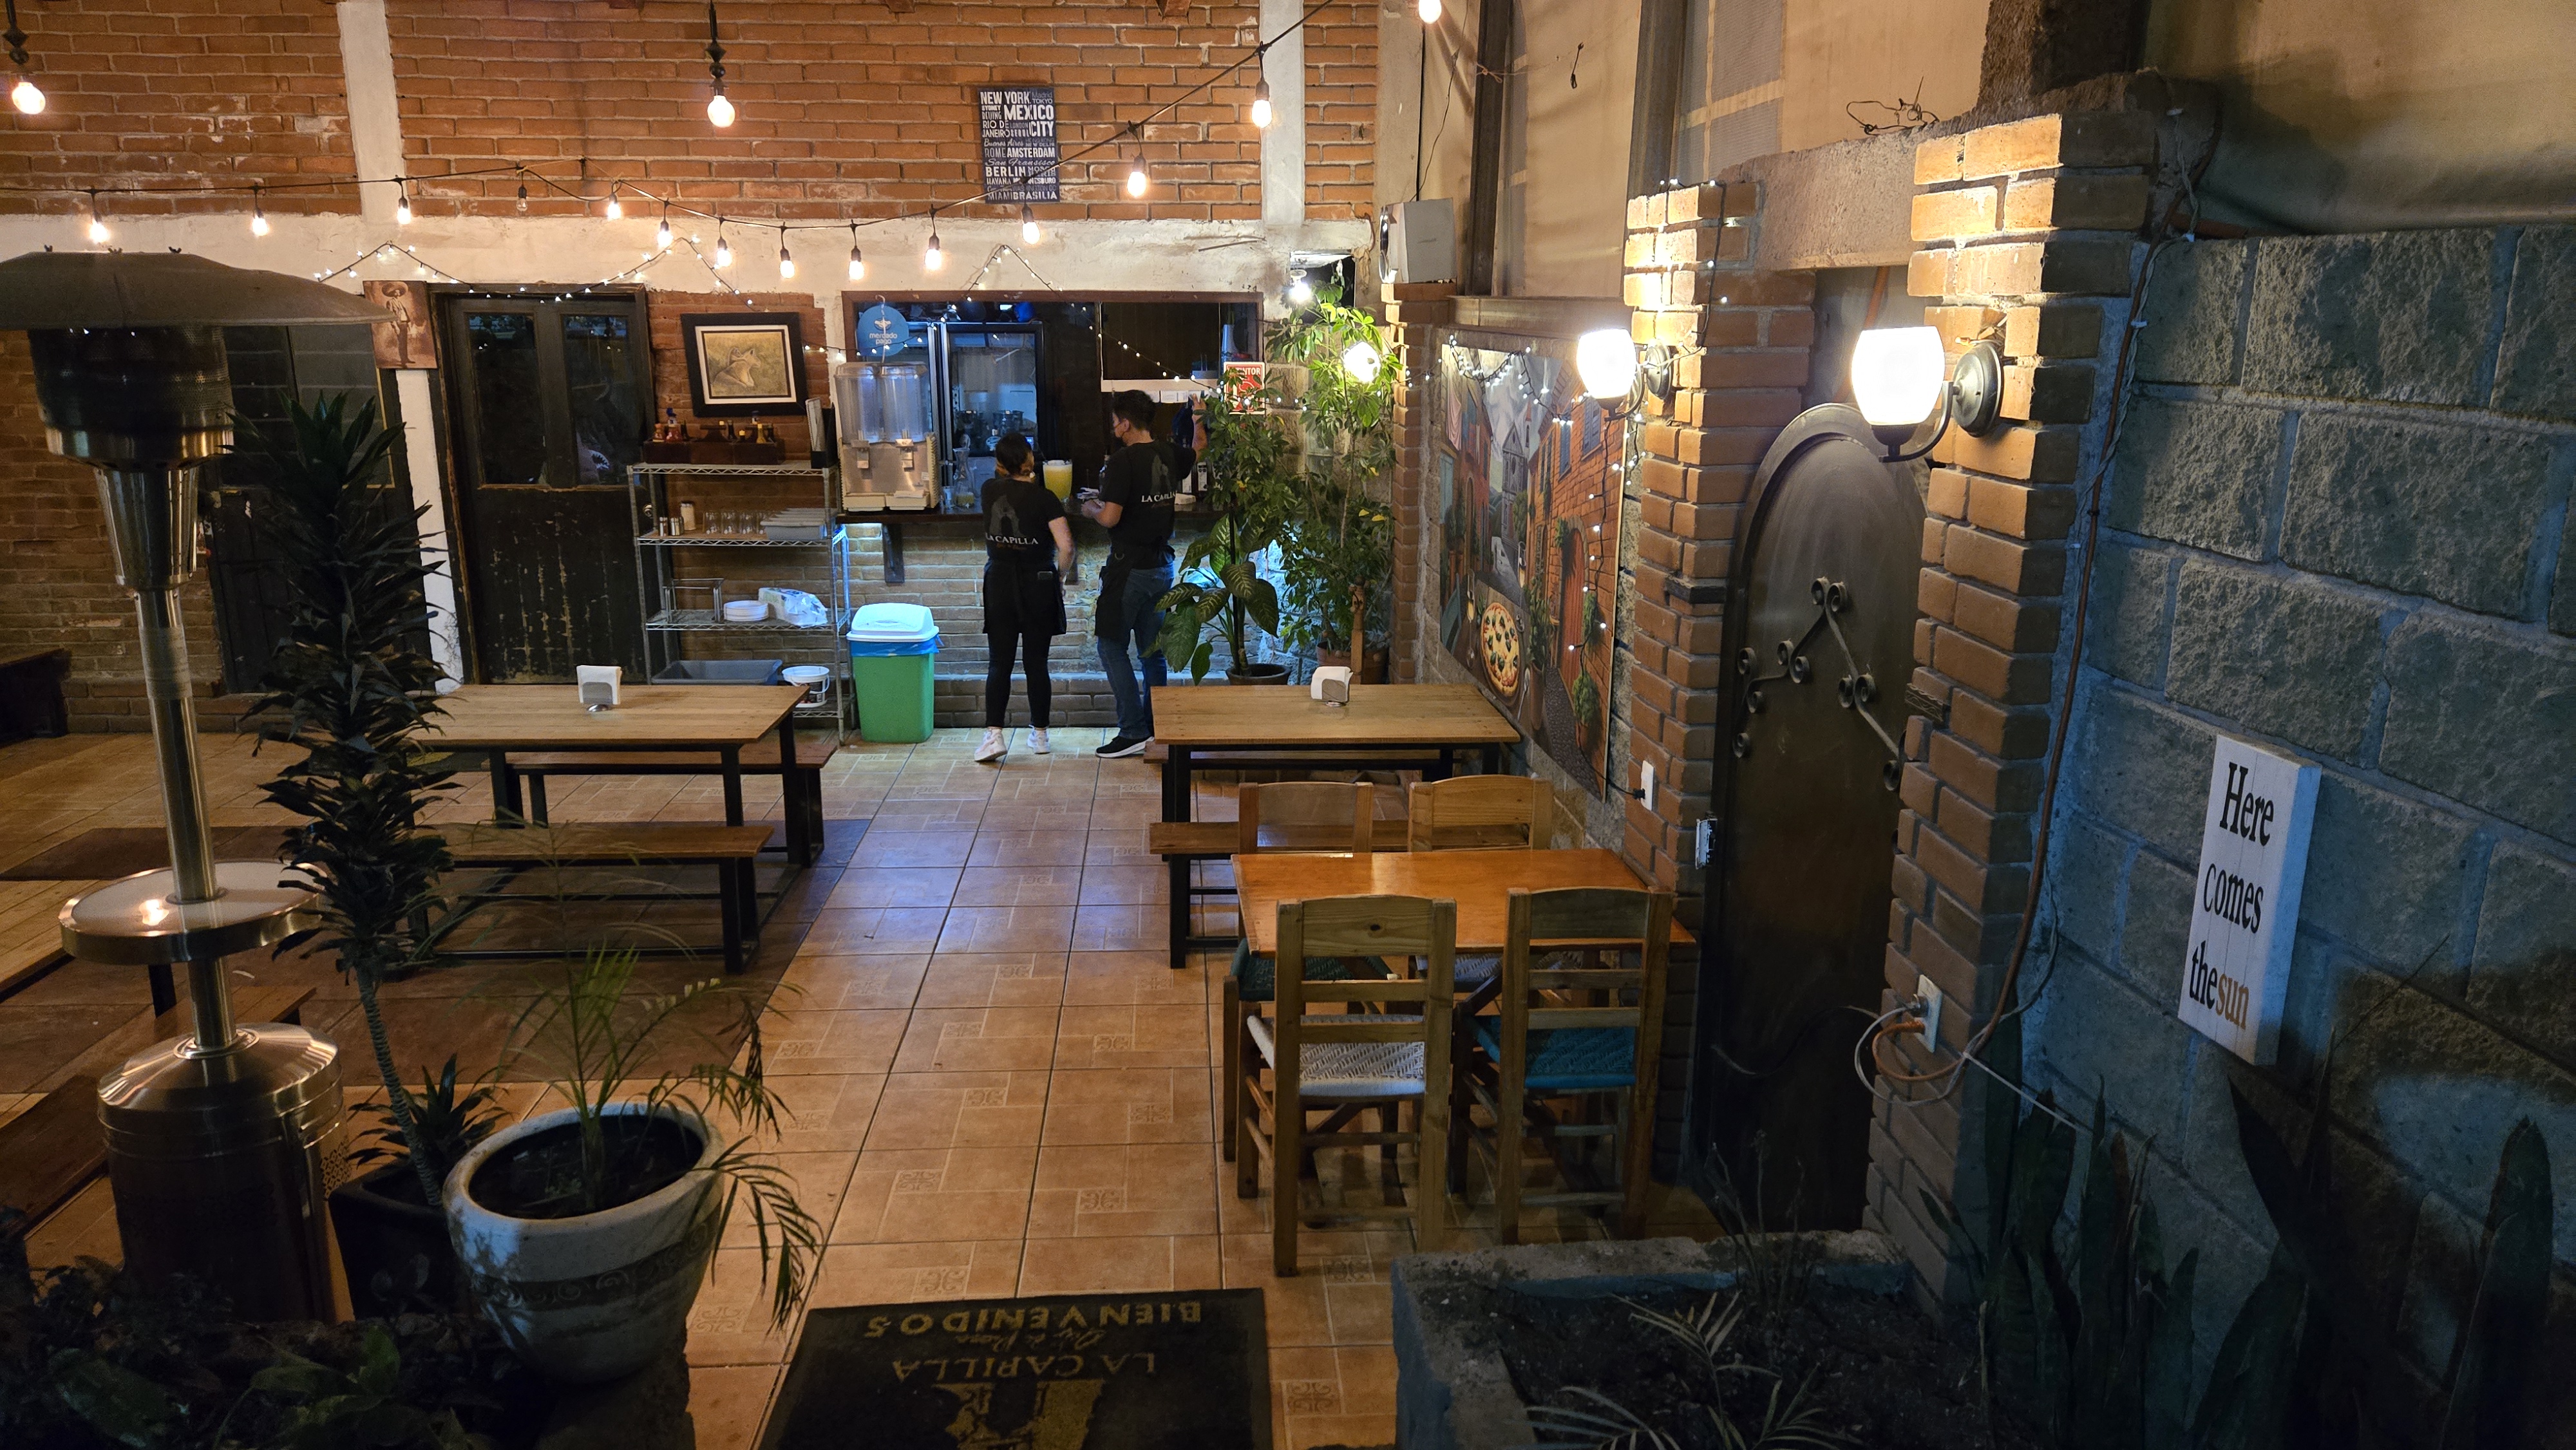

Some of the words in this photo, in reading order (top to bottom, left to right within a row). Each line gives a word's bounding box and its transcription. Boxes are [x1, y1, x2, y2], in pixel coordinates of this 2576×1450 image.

[980, 91, 1002, 104] NEW
[1004, 91, 1030, 104] YORK
[982, 111, 1002, 120] BEIJING
[1003, 104, 1054, 120] MEXICO
[983, 120, 997, 129] RIO
[999, 120, 1009, 129] DE
[1029, 121, 1054, 137] CITY
[982, 129, 1010, 138] JANEIRO
[1010, 129, 1030, 137] SEOUL
[984, 138, 1006, 147] Buenos
[1007, 138, 1023, 147] Aires
[985, 147, 1006, 158] ROME
[1007, 147, 1056, 158] AMSTERDAM
[985, 158, 1007, 166] San
[985, 166, 1026, 177] BERLIN
[988, 192, 1013, 200] MIAMI
[1013, 191, 1057, 200] BRASILIA
[985, 532, 994, 541] LA
[995, 536, 1039, 545] CAPILLA
[2219, 761, 2274, 846] Here
[2204, 863, 2264, 934] comes
[864, 1301, 1201, 1337] BIENVENIDOS
[893, 1355, 1084, 1382] CAPILLA
[1102, 1352, 1155, 1374] LA
